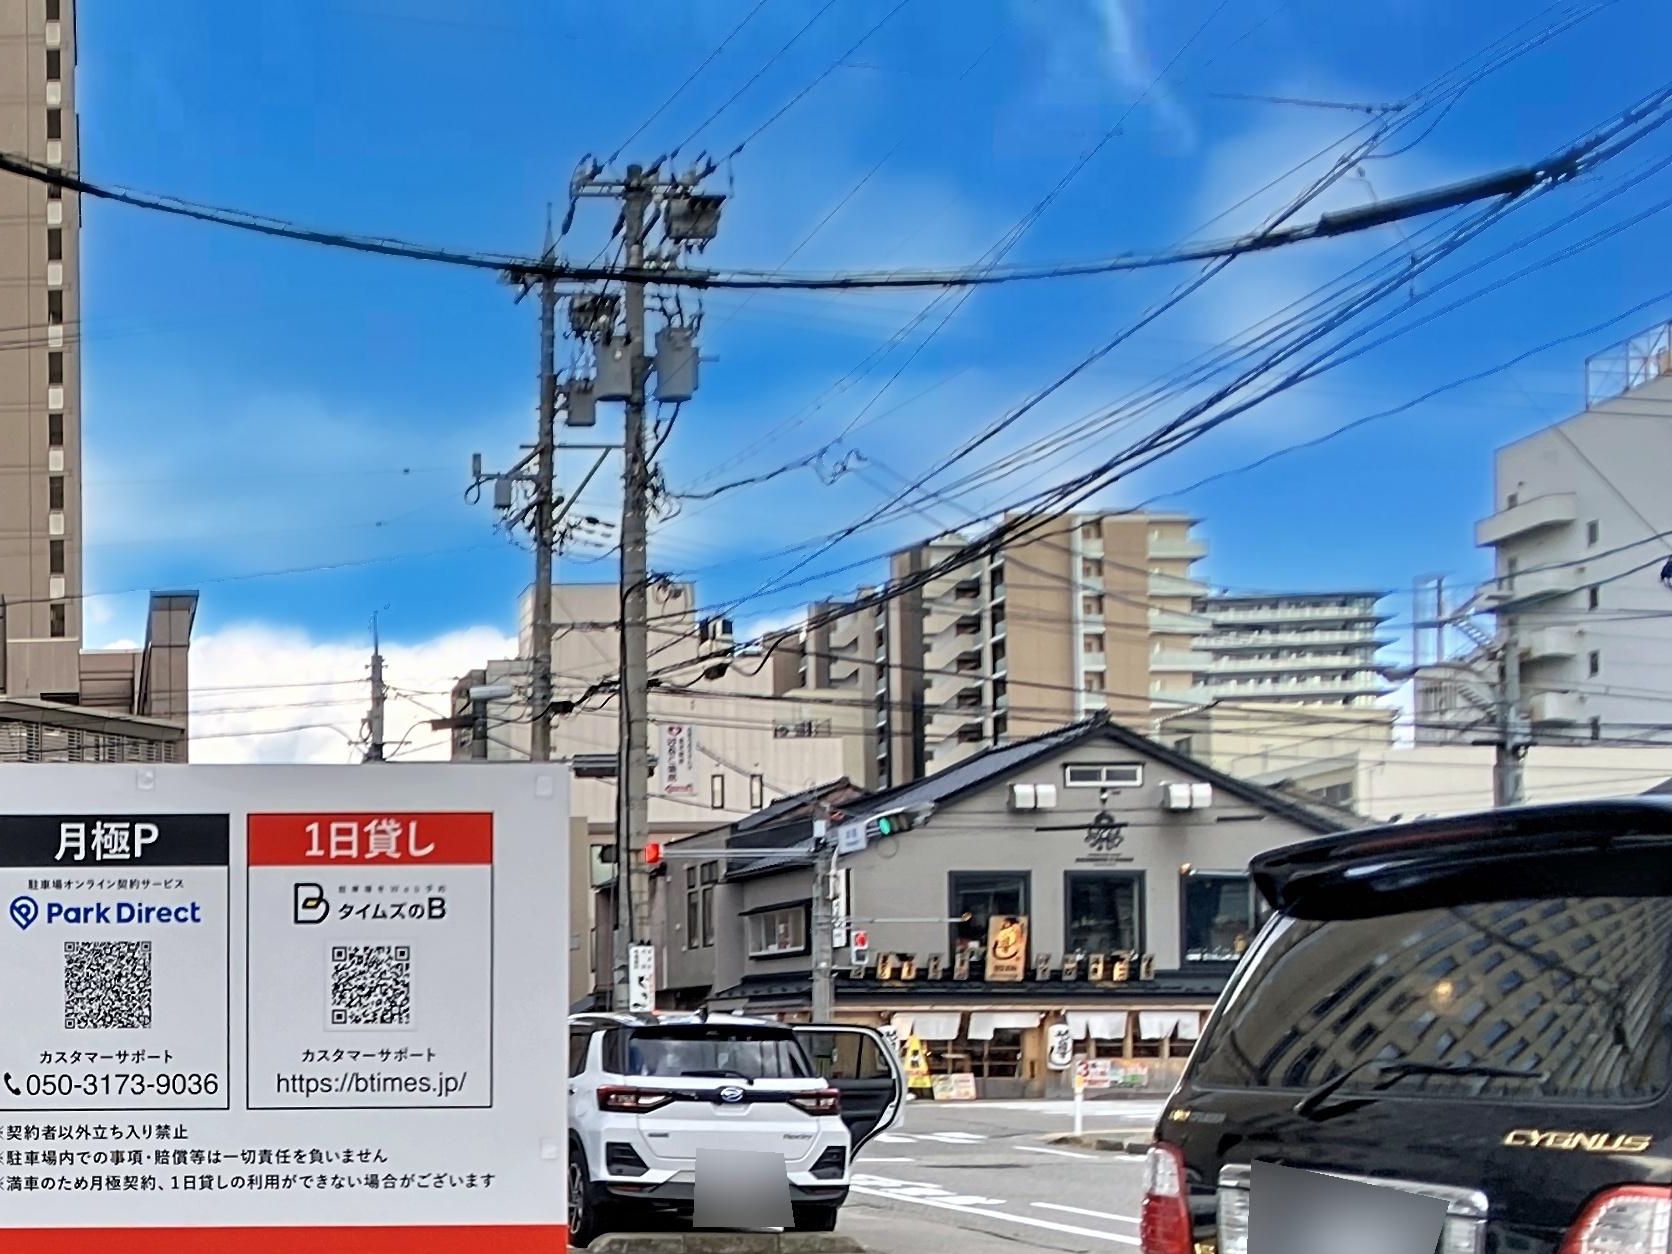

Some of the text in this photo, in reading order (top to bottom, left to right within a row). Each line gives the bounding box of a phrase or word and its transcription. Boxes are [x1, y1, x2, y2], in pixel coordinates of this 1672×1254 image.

[55, 820, 159, 861] 月極P
[305, 819, 436, 859] 1日貸し
[28, 878, 184, 891] 駐車場オンライン契約サービス
[47, 901, 201, 924] Park Direct
[338, 897, 446, 921] タイムズのB
[39, 1048, 173, 1065] カスタマーサポート
[302, 1047, 436, 1063] カスタマーサポート
[26, 1073, 219, 1096] 050-3173-9036
[276, 1072, 467, 1097] https://btimes.jp/
[1503, 1128, 1652, 1152] CYGNUS
